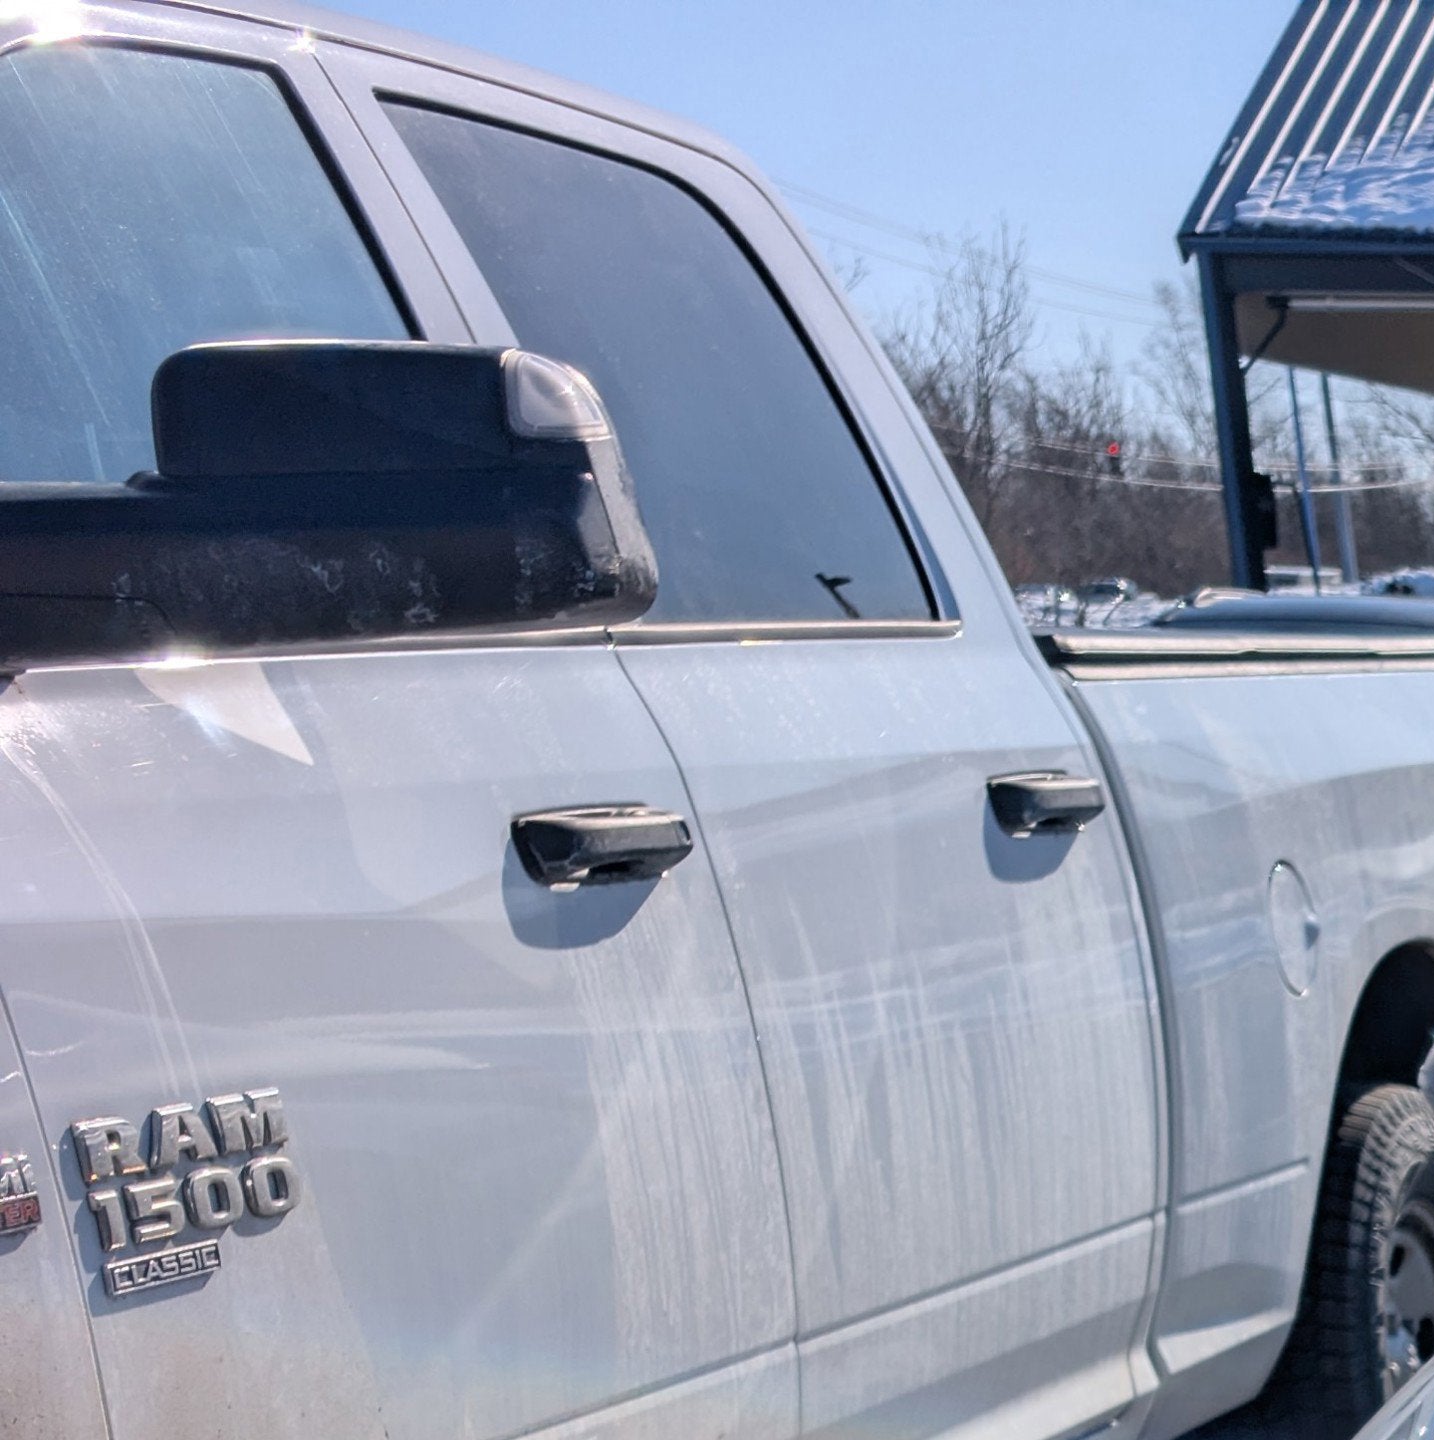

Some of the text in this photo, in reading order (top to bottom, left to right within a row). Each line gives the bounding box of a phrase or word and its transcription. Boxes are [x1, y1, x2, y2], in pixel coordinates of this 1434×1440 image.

[70, 1086, 289, 1188] RAM
[87, 1156, 300, 1253] 1500
[113, 1246, 219, 1289] CLASSIC
